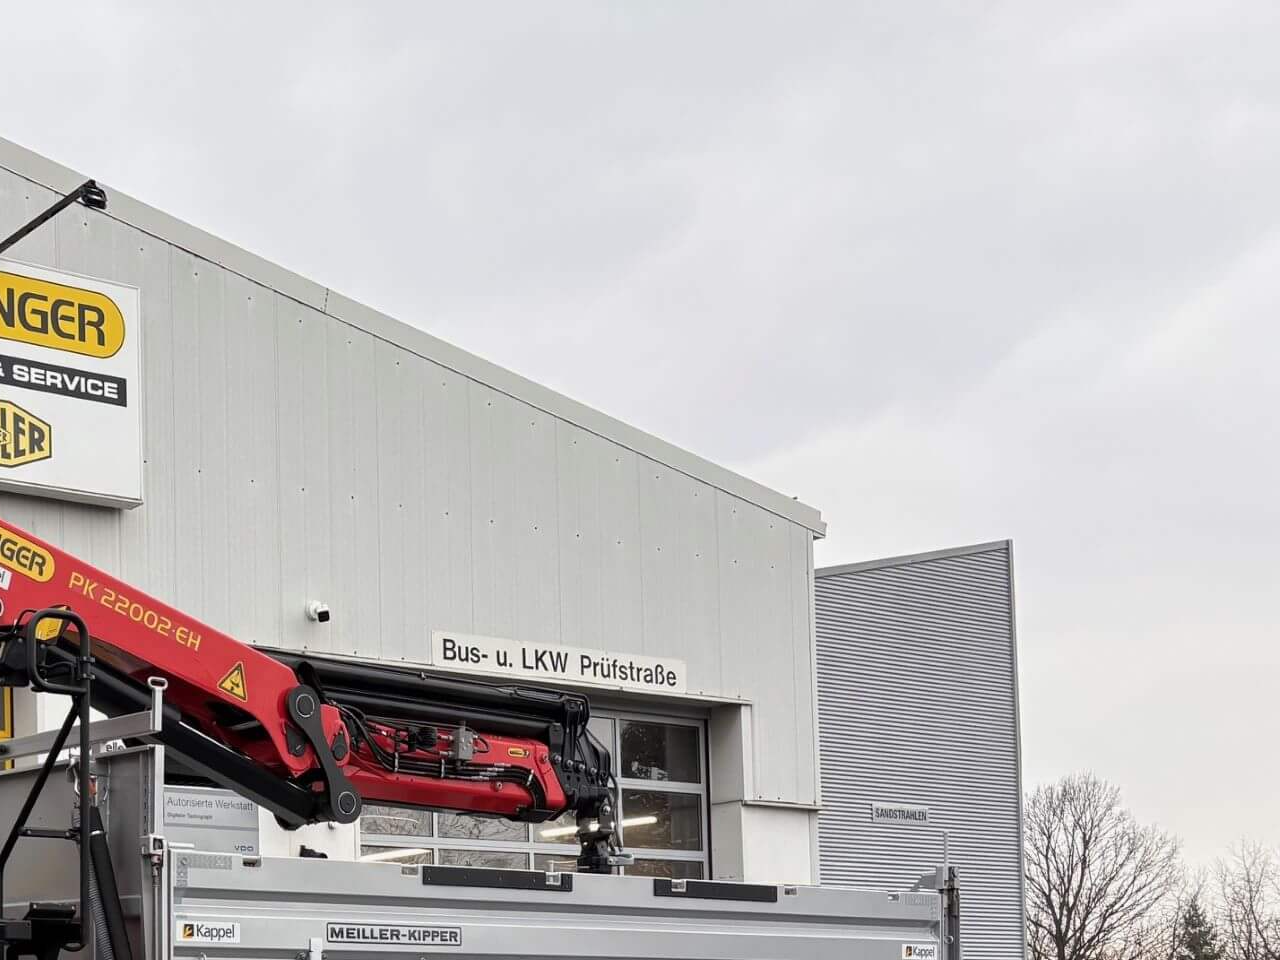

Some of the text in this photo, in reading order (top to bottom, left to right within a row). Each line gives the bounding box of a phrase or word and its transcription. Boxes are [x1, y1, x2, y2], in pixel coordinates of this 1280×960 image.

[12, 364, 119, 400] SERVICE
[69, 571, 96, 600] PK
[442, 638, 677, 688] Bus- u. LKW Prüfstraße
[215, 799, 254, 812] Werkstatt
[875, 807, 927, 821] SANDSTRAHLEN
[196, 923, 235, 942] Kappel
[329, 926, 459, 943] MEILLER-KIPPER
[912, 945, 935, 959] Kappel
